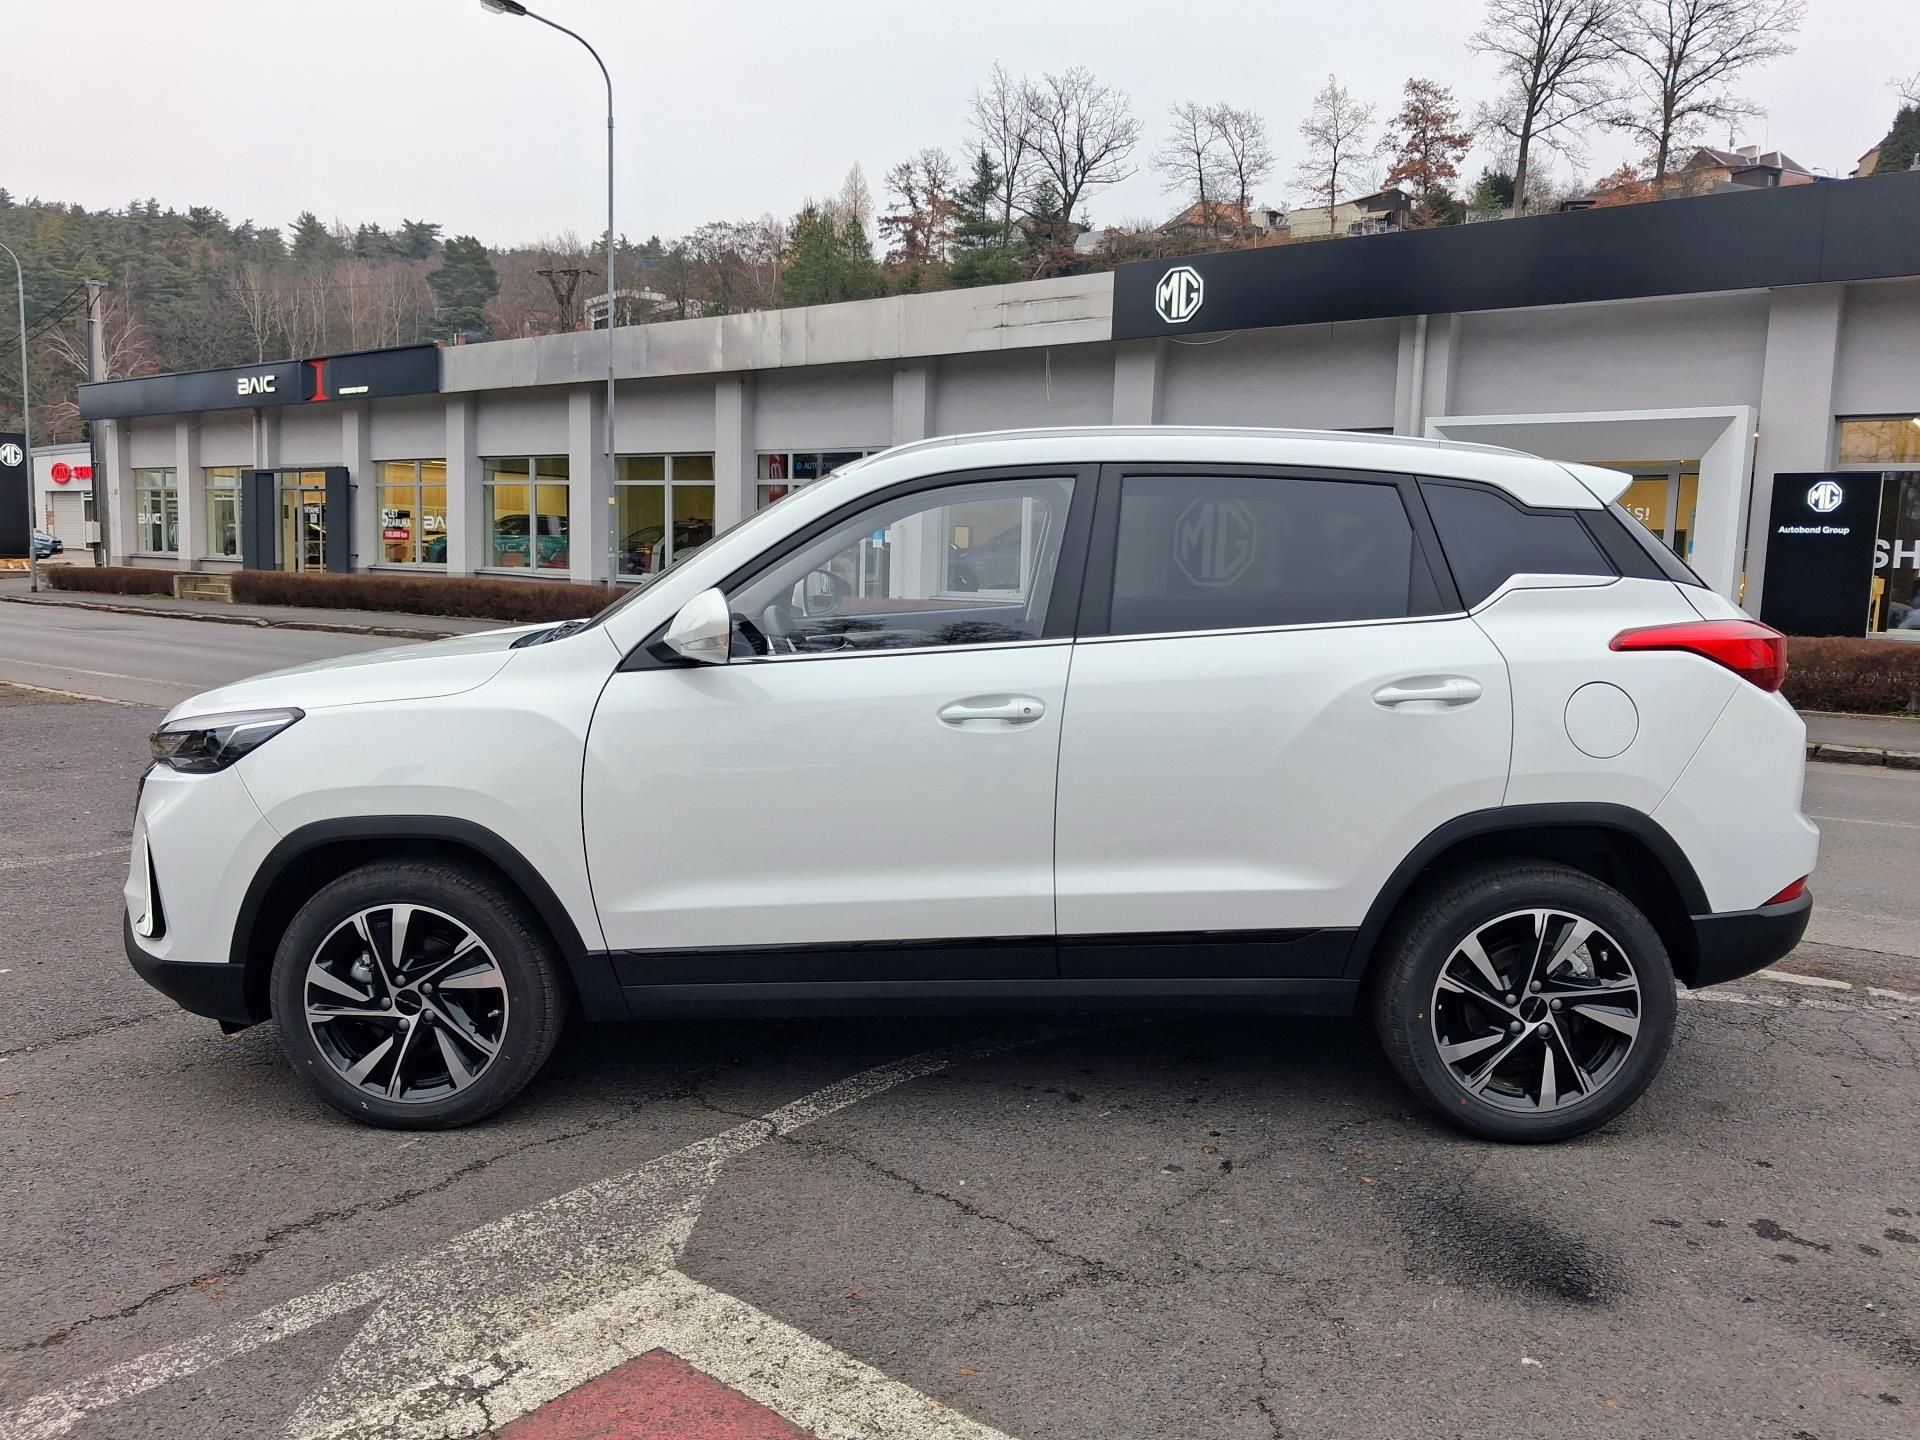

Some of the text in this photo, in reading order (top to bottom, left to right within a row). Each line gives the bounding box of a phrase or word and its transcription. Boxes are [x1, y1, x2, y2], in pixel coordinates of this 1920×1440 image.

[1159, 270, 1199, 318] MG
[238, 375, 275, 394] BAIC
[0, 445, 21, 465] MG
[1810, 484, 1839, 510] MG
[1778, 526, 1850, 535] Autobond Group
